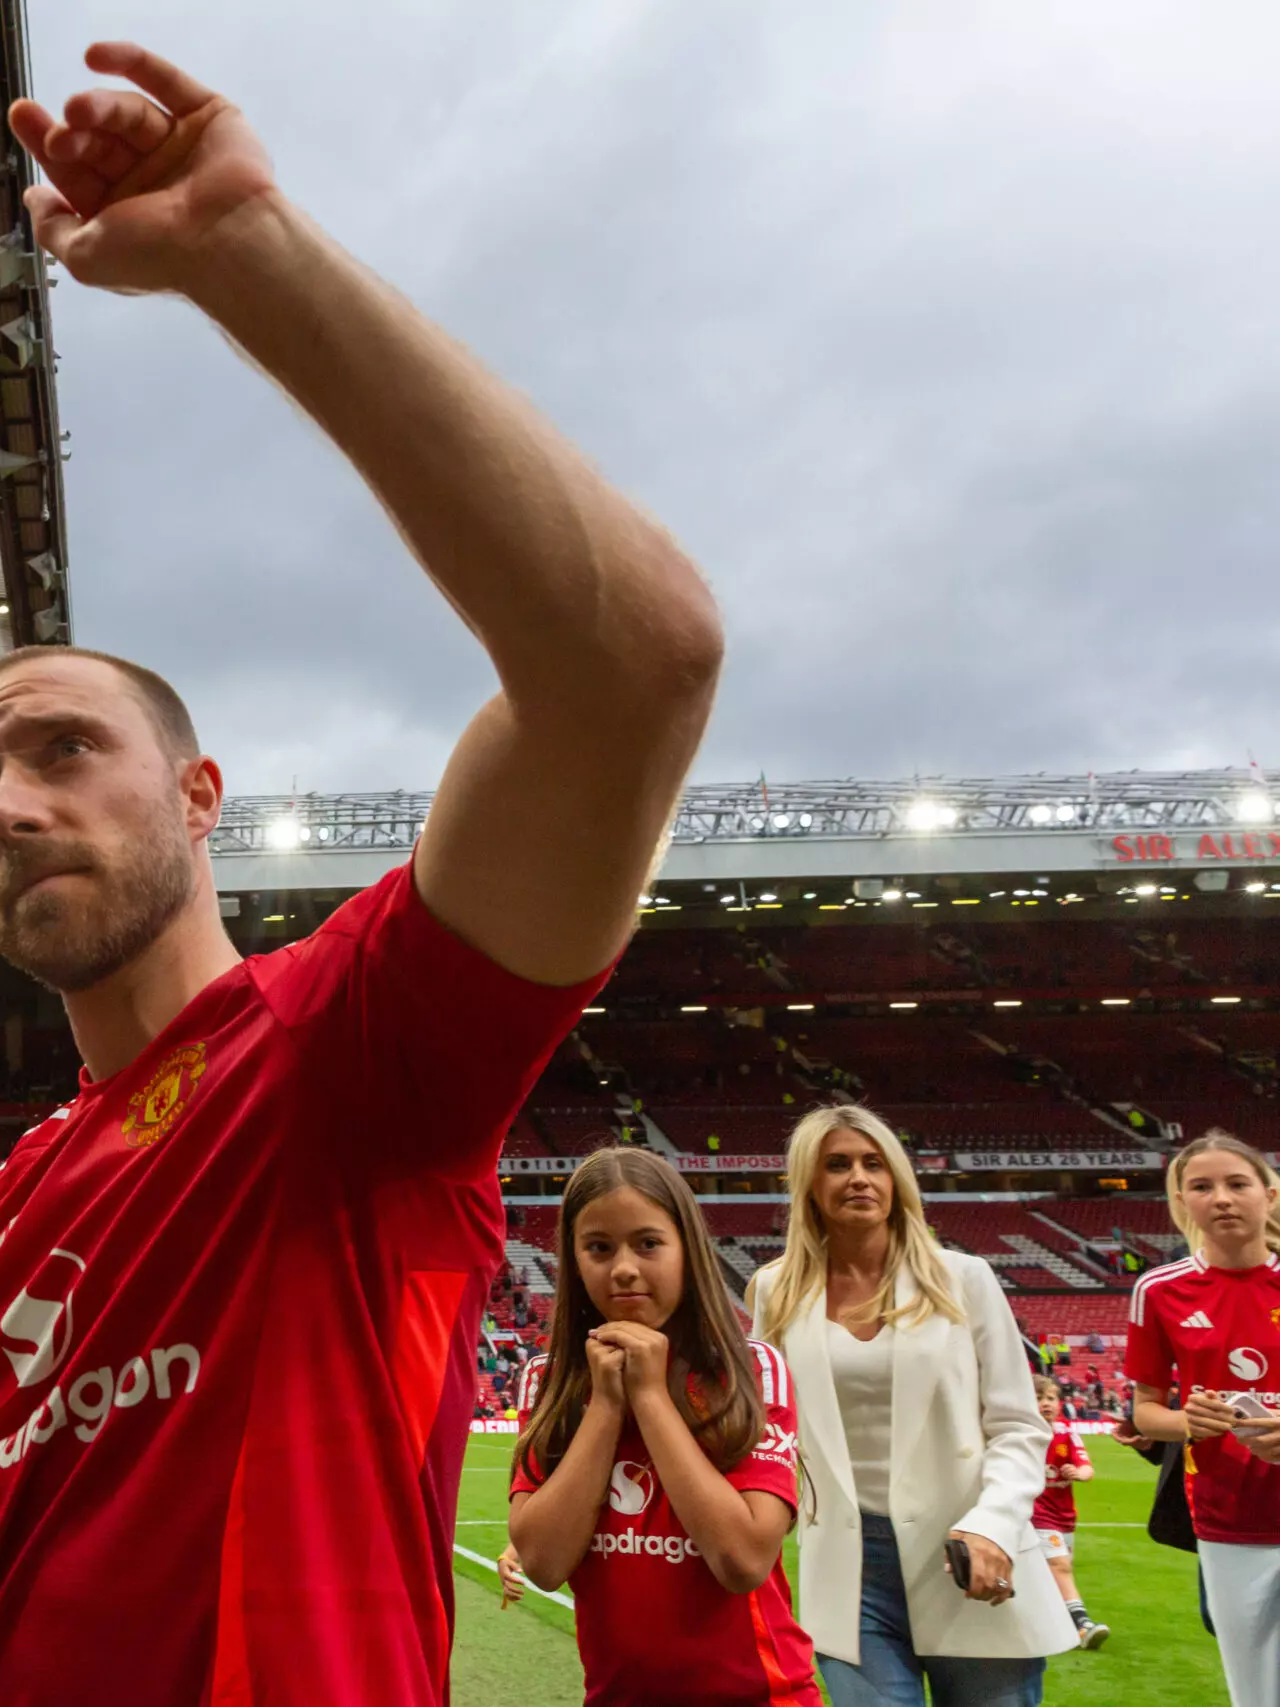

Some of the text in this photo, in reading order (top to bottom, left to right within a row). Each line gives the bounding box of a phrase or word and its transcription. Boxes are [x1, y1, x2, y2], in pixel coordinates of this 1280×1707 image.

[1112, 833, 1175, 862] SIR
[676, 1157, 788, 1169] THE IMPOSSI
[972, 1153, 1146, 1166] SIR ALEX 26 YEARS
[591, 1527, 702, 1564] apdrago
